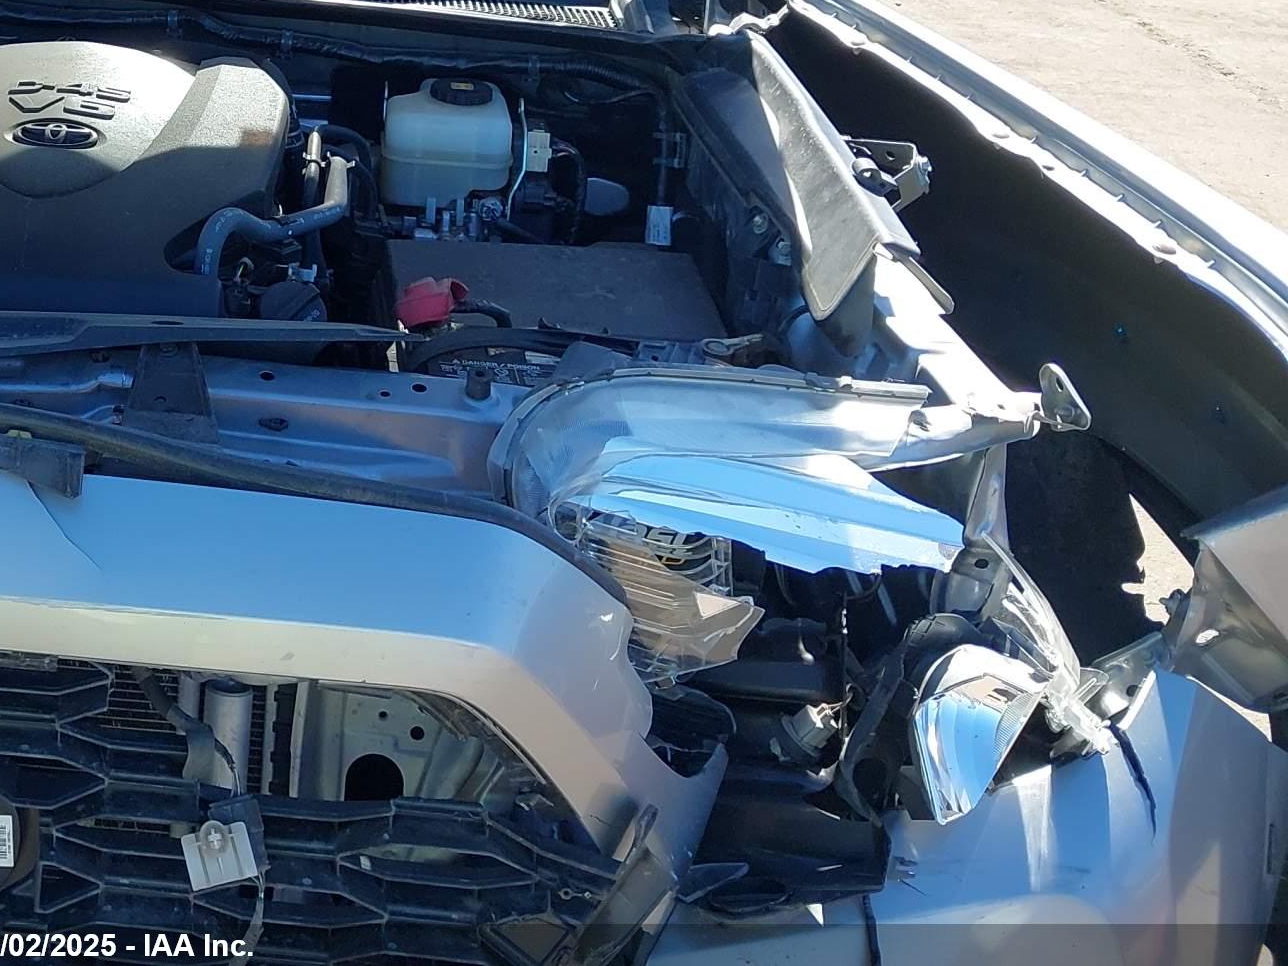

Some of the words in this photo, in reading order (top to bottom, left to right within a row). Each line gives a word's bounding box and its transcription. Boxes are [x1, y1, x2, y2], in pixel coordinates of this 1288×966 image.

[7, 81, 132, 104] D-4S
[8, 96, 116, 121] V6
[461, 359, 499, 369] DANGER
[506, 363, 541, 371] POISON
